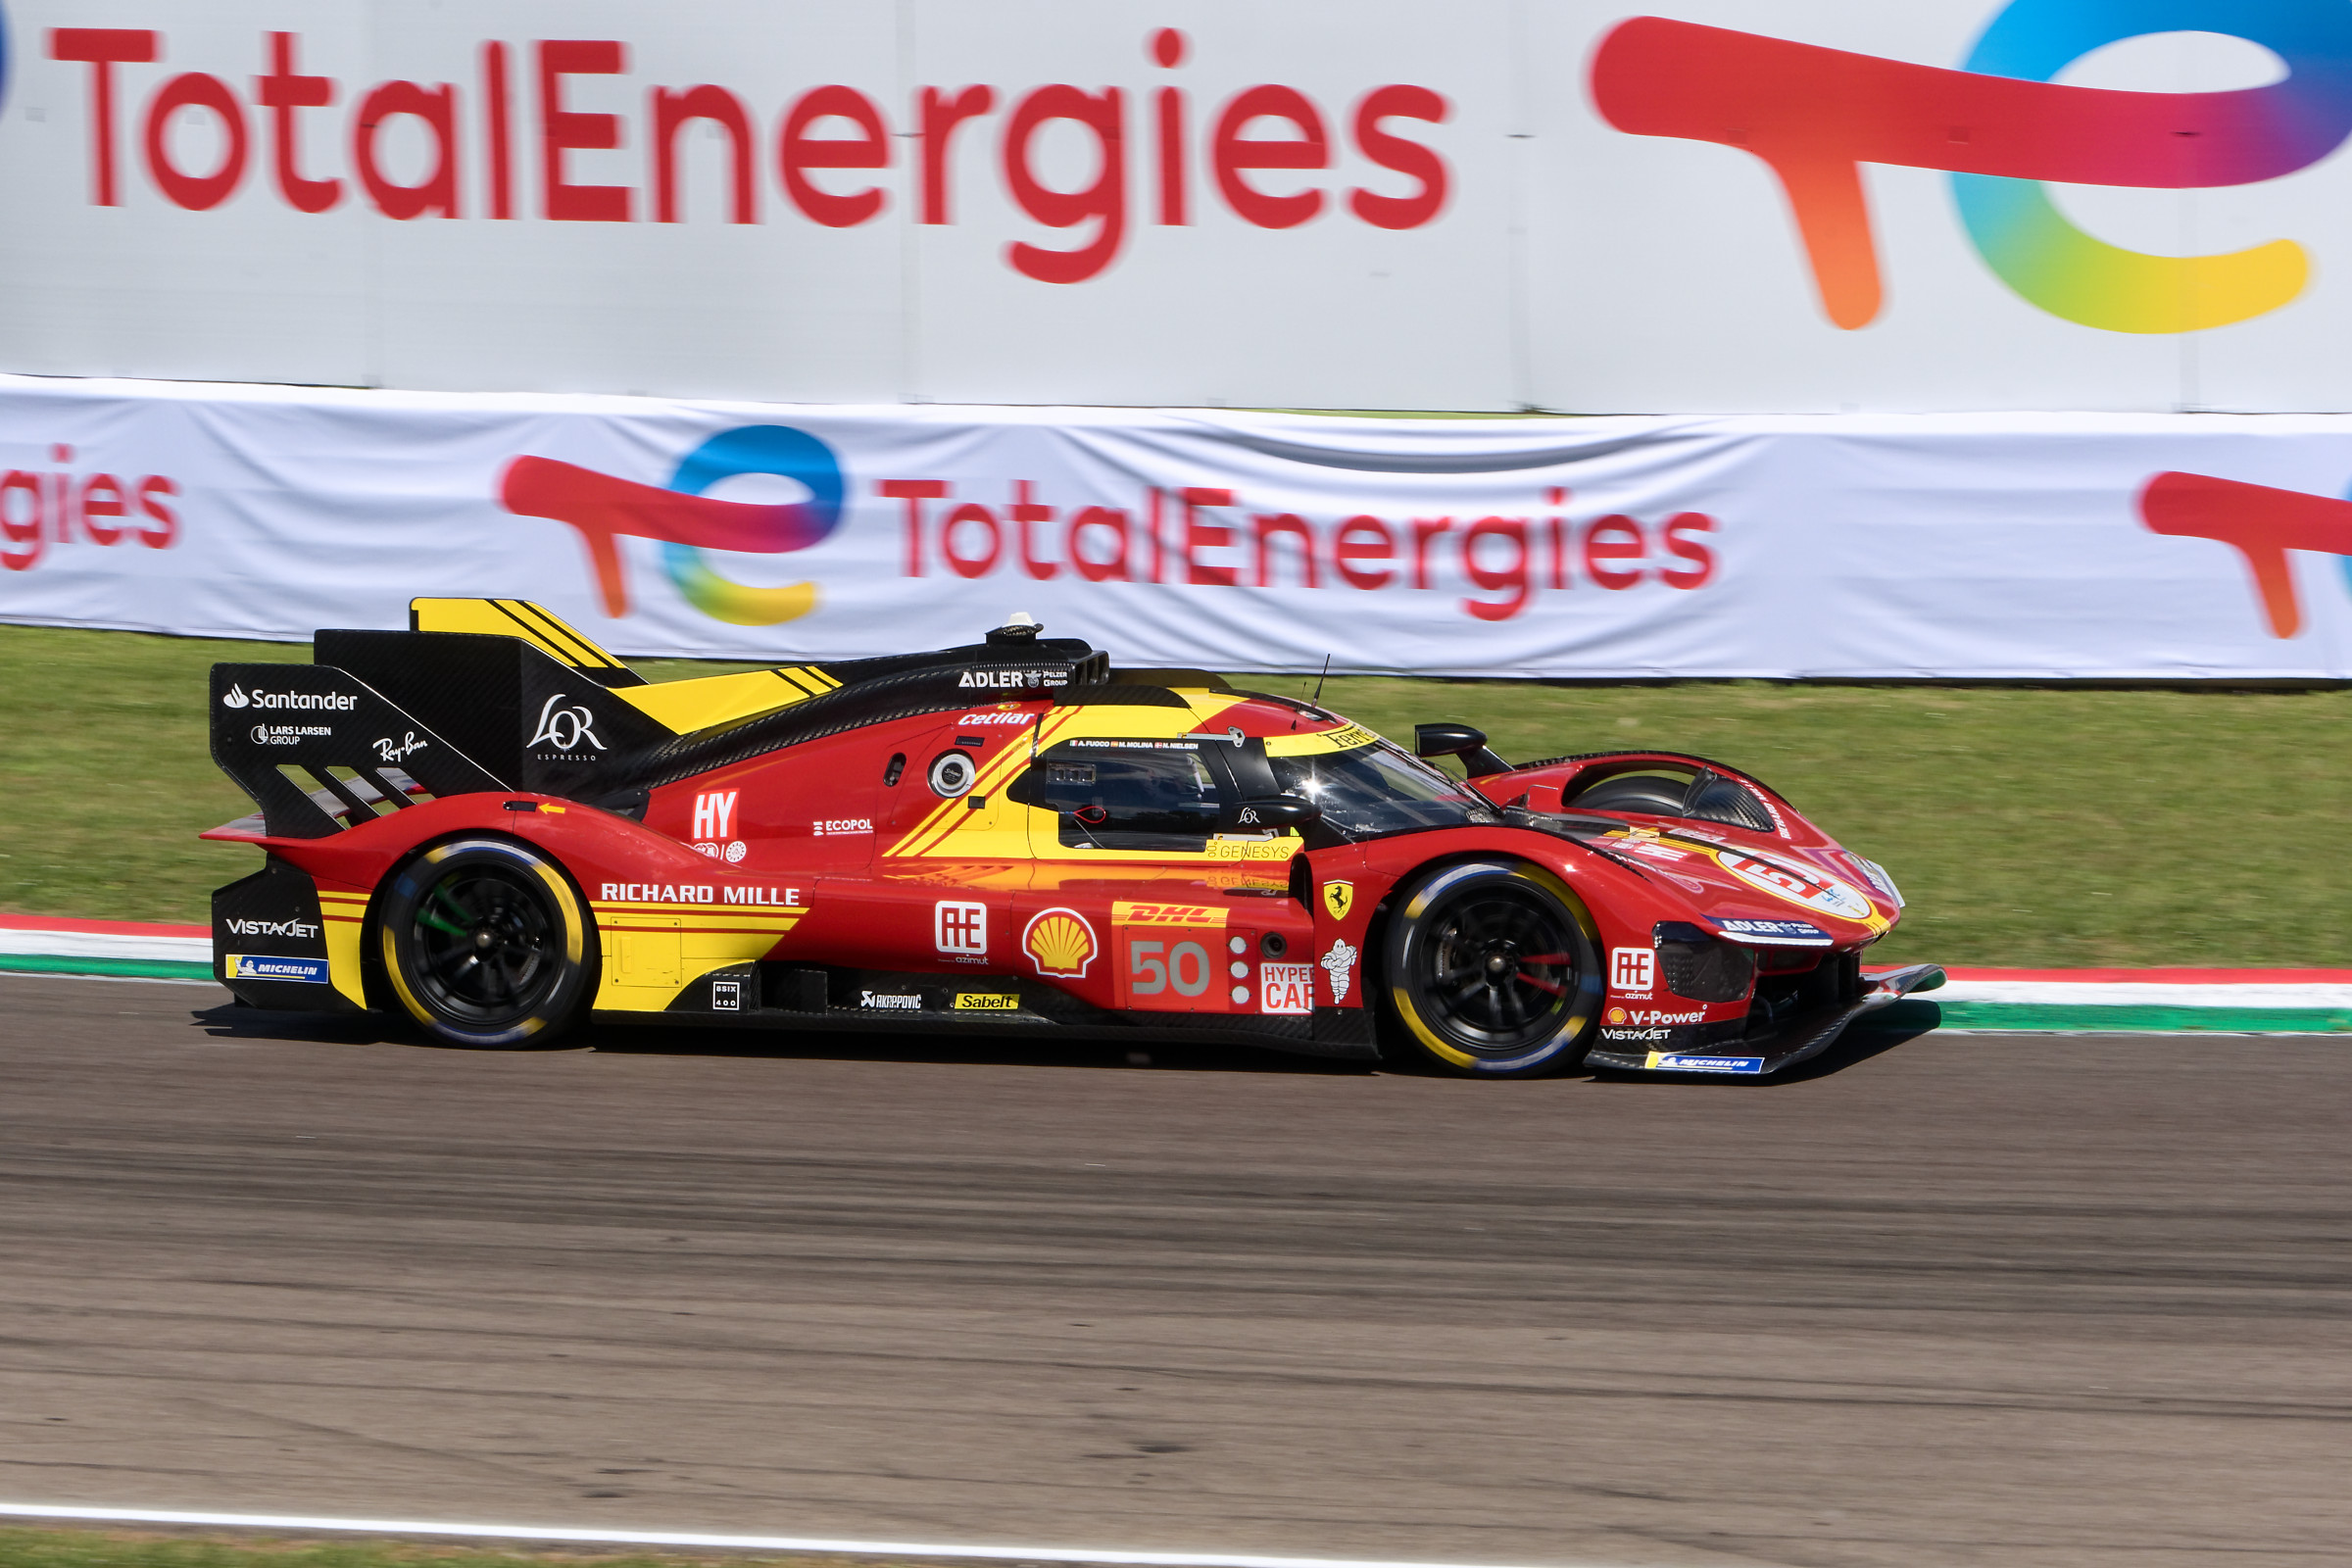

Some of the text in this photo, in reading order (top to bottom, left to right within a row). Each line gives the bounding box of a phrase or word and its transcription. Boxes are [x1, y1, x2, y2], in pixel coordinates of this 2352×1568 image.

[43, 26, 1457, 284] TotalEnergies
[875, 479, 1717, 621] TotalEnergies
[957, 671, 1023, 688] ADLER
[252, 689, 358, 710] Santander
[270, 725, 331, 736] LARS LARSEN
[270, 737, 300, 746] GROUP
[694, 792, 737, 839] HY
[825, 819, 873, 831] ECOPOL
[1220, 845, 1290, 858] GENESYS
[601, 883, 800, 906] RICHARD MILLE
[1128, 905, 1211, 923] DHL
[225, 917, 318, 938] VISTAJET
[1722, 919, 1784, 933] ADLER
[955, 954, 989, 965] azimut
[258, 964, 318, 975] MICHELIN
[1130, 941, 1210, 997] 50
[962, 995, 1011, 1007] Sabelt
[1625, 990, 1653, 1001] azimut
[1630, 1010, 1705, 1025] V-Power
[1601, 1026, 1672, 1040] VISTAJET
